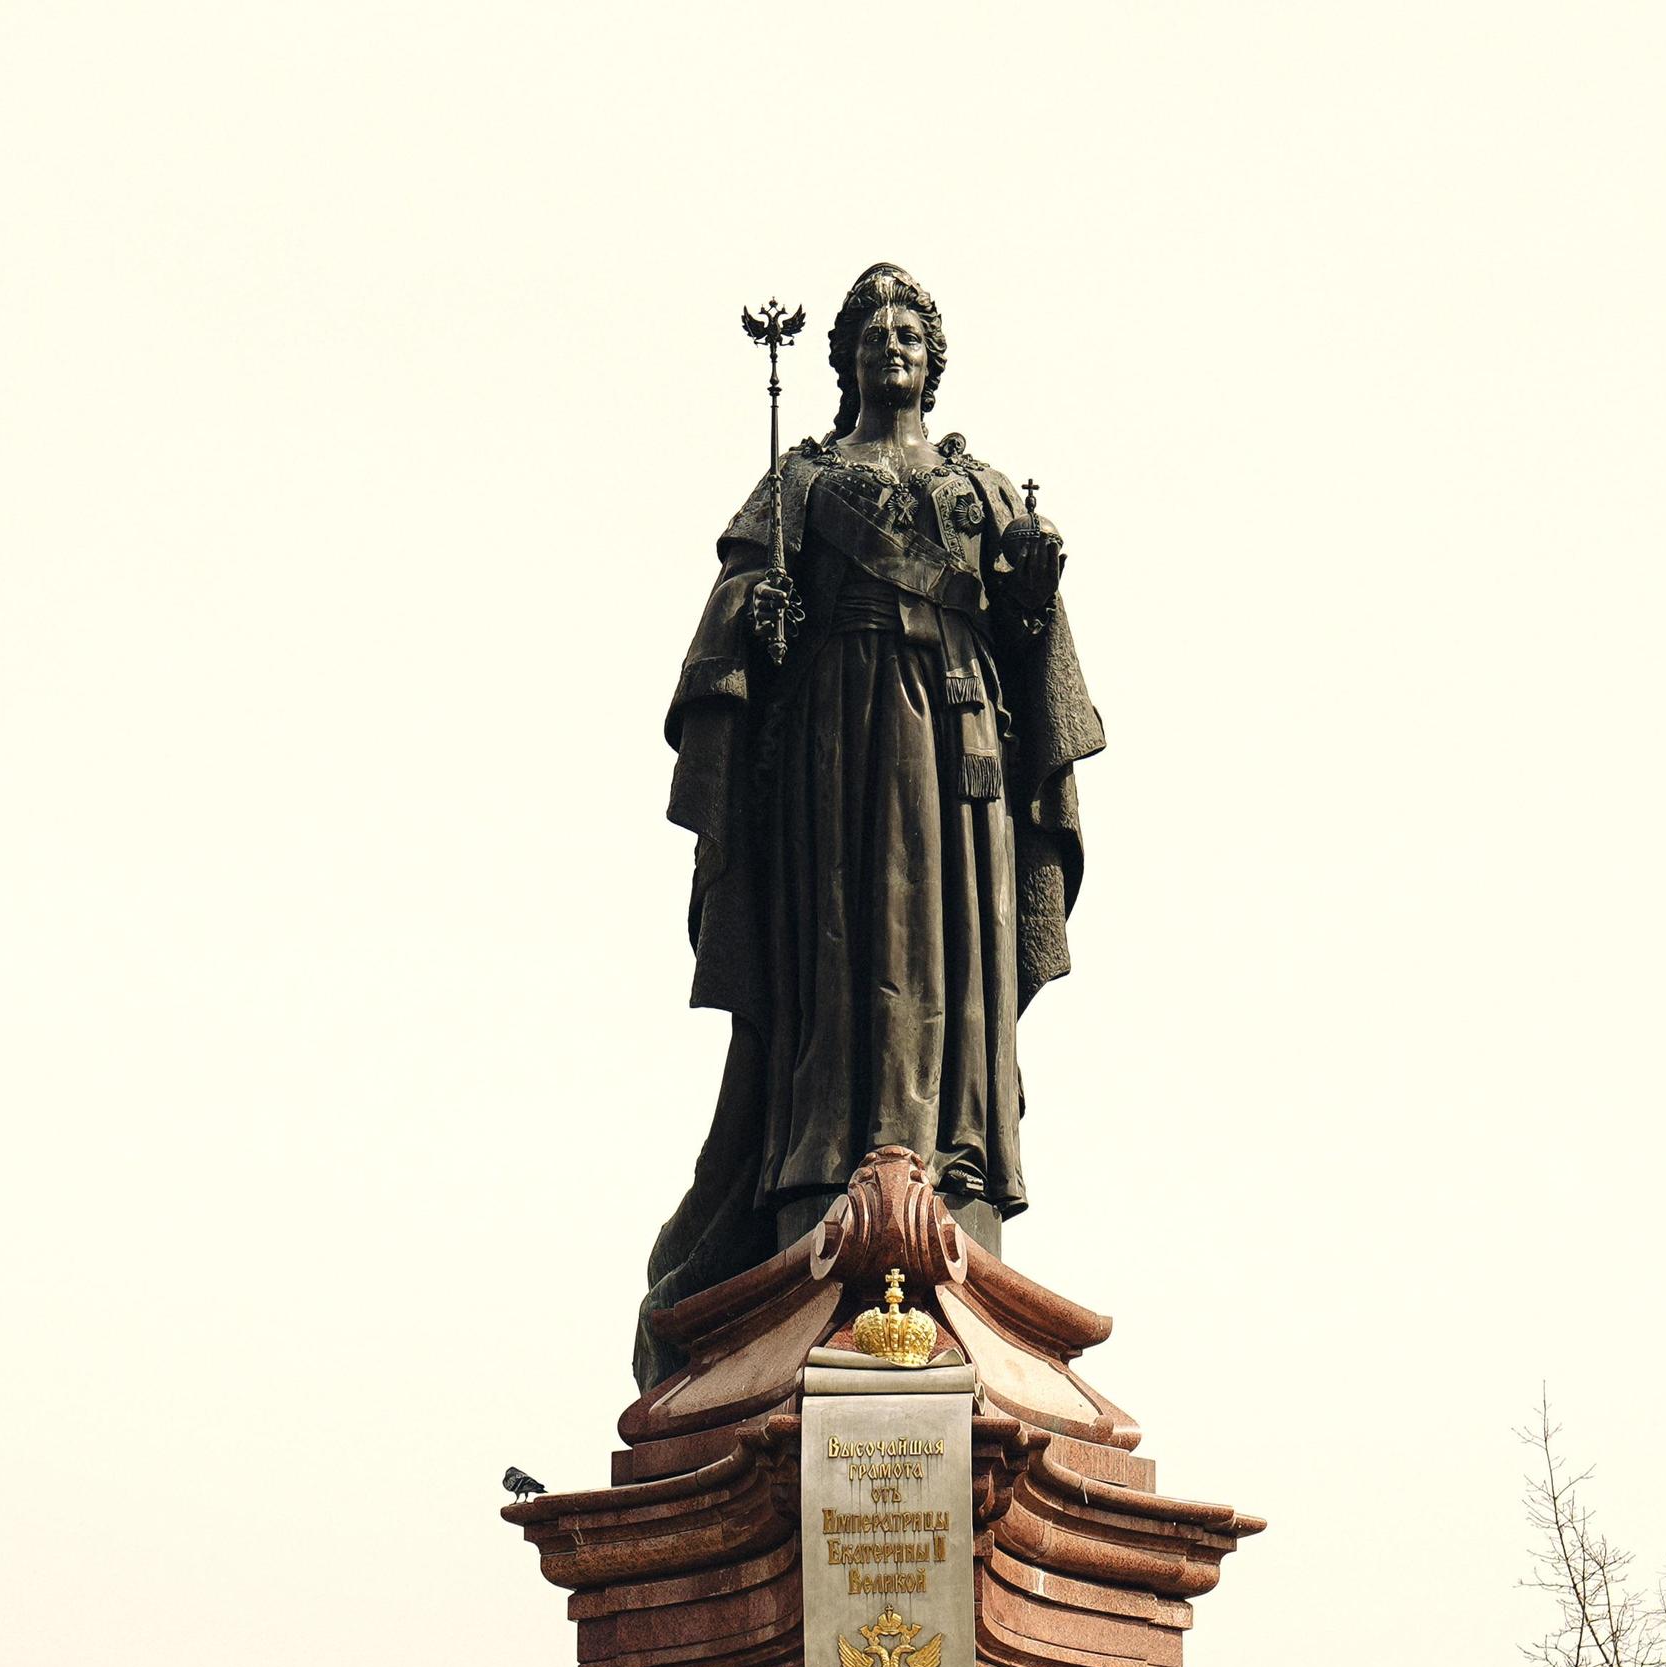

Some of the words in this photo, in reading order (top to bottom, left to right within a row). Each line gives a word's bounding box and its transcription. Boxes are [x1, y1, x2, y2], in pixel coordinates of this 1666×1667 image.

[827, 1435, 945, 1458] Высочайшая
[848, 1462, 924, 1481] грамота
[870, 1487, 902, 1503] отъ
[822, 1507, 950, 1535] Императрицы
[827, 1538, 929, 1565] Екатерины
[847, 1568, 927, 1595] Великой
